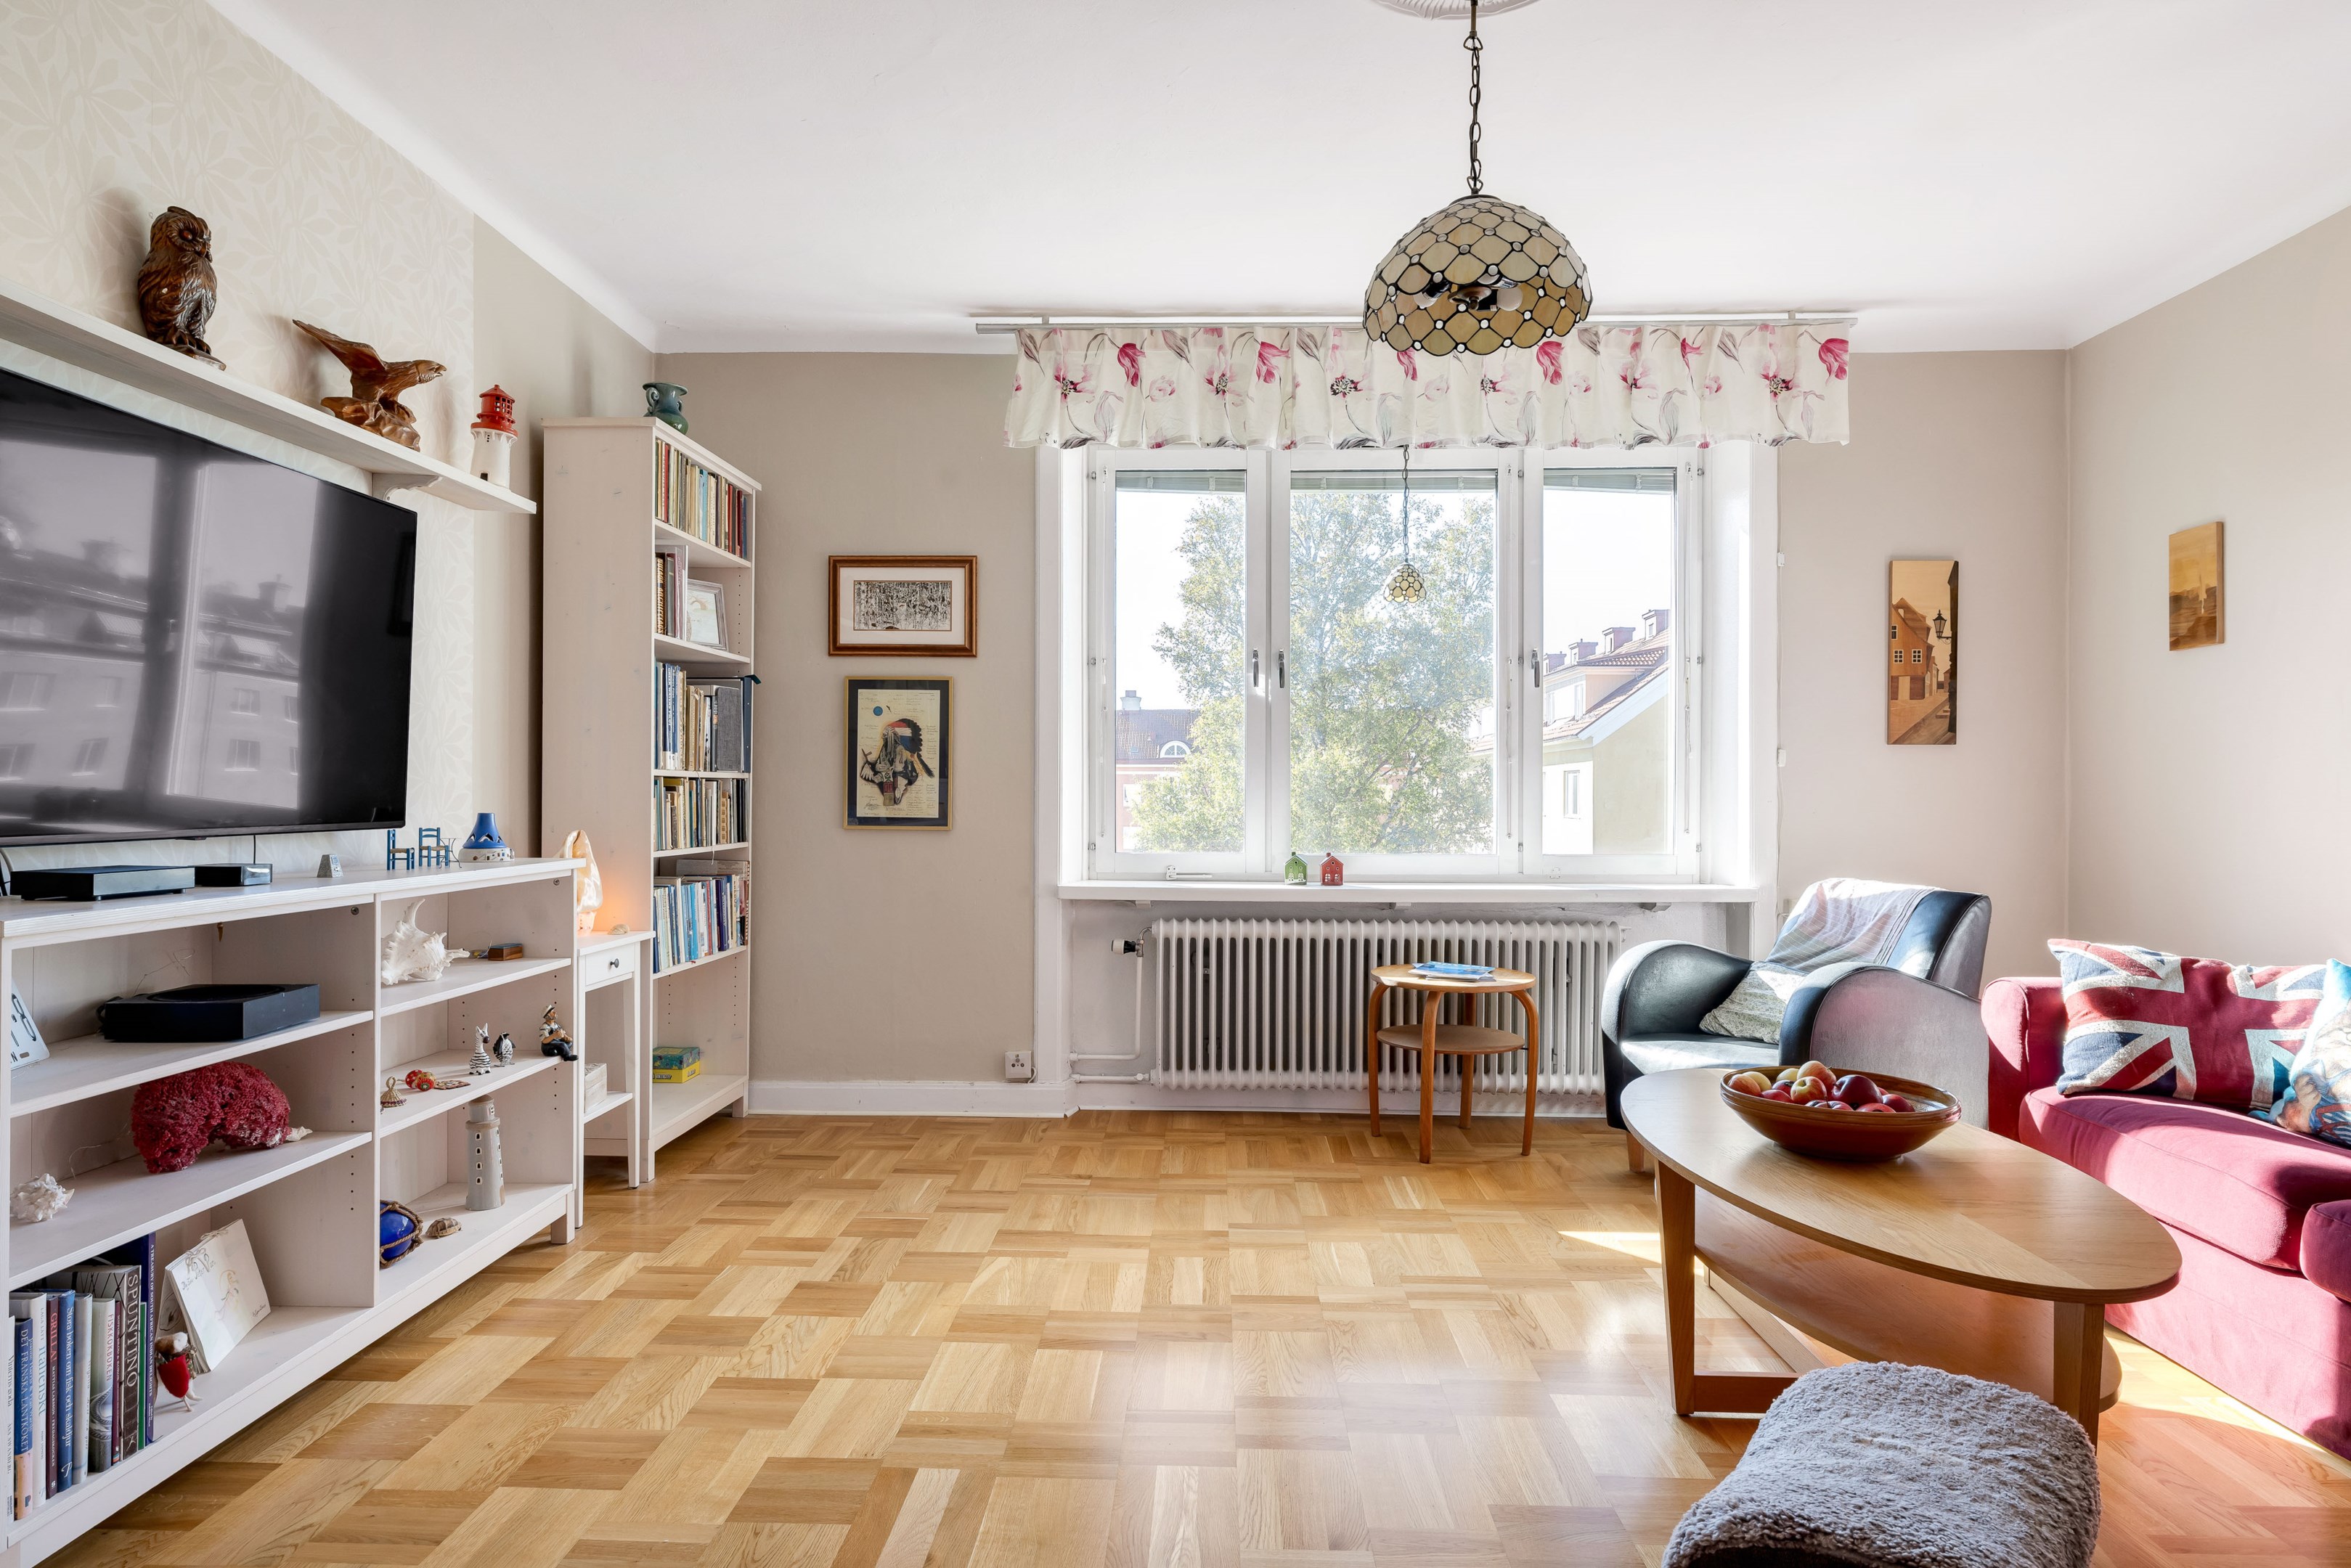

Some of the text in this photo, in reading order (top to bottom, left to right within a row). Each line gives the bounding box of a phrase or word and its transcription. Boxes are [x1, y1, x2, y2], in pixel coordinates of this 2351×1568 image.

[127, 1273, 139, 1387] SPUNTINO
[65, 1362, 72, 1376] om
[21, 1395, 30, 1451] LANTKÖKET
[62, 1414, 73, 1447] skaldjur
